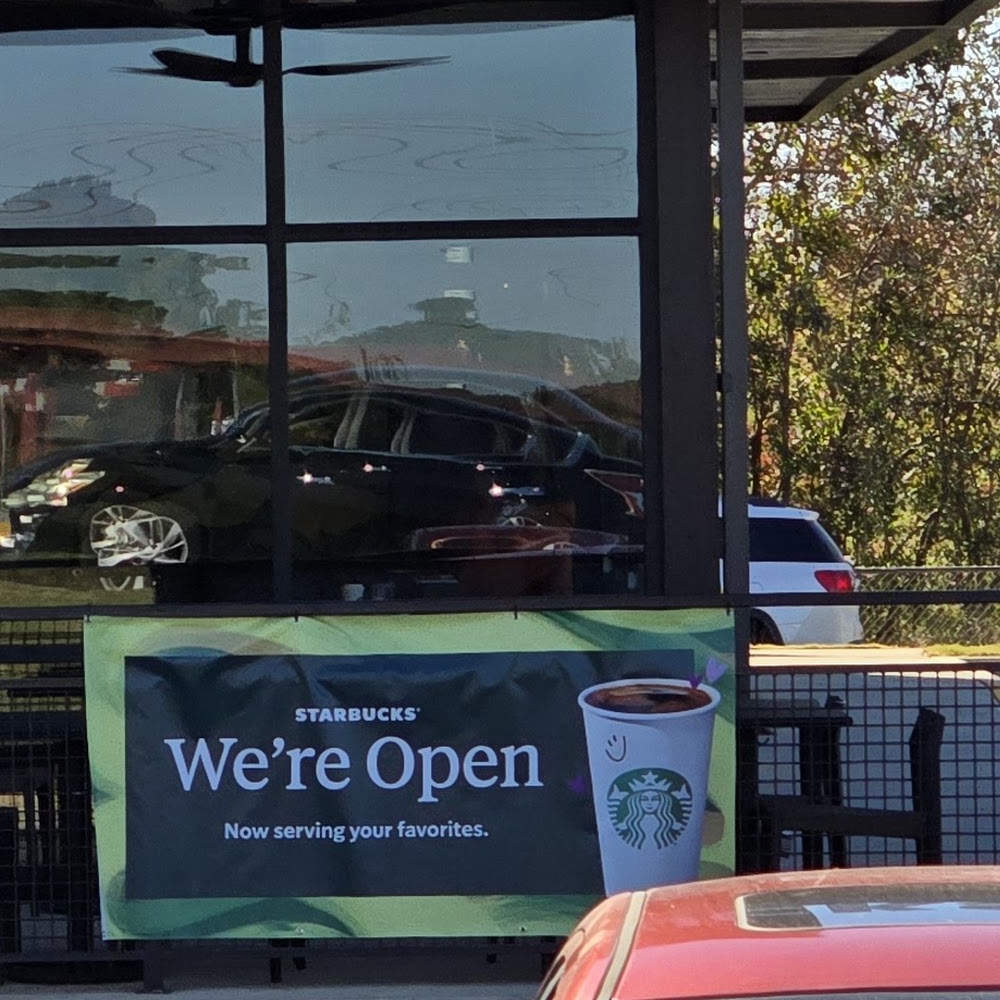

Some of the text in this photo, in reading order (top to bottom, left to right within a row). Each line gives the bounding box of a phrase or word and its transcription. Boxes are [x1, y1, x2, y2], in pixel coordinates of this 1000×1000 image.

[295, 707, 417, 723] STARBUCKS
[164, 736, 544, 803] We're Open
[224, 820, 489, 843] Now serving your favorites.
